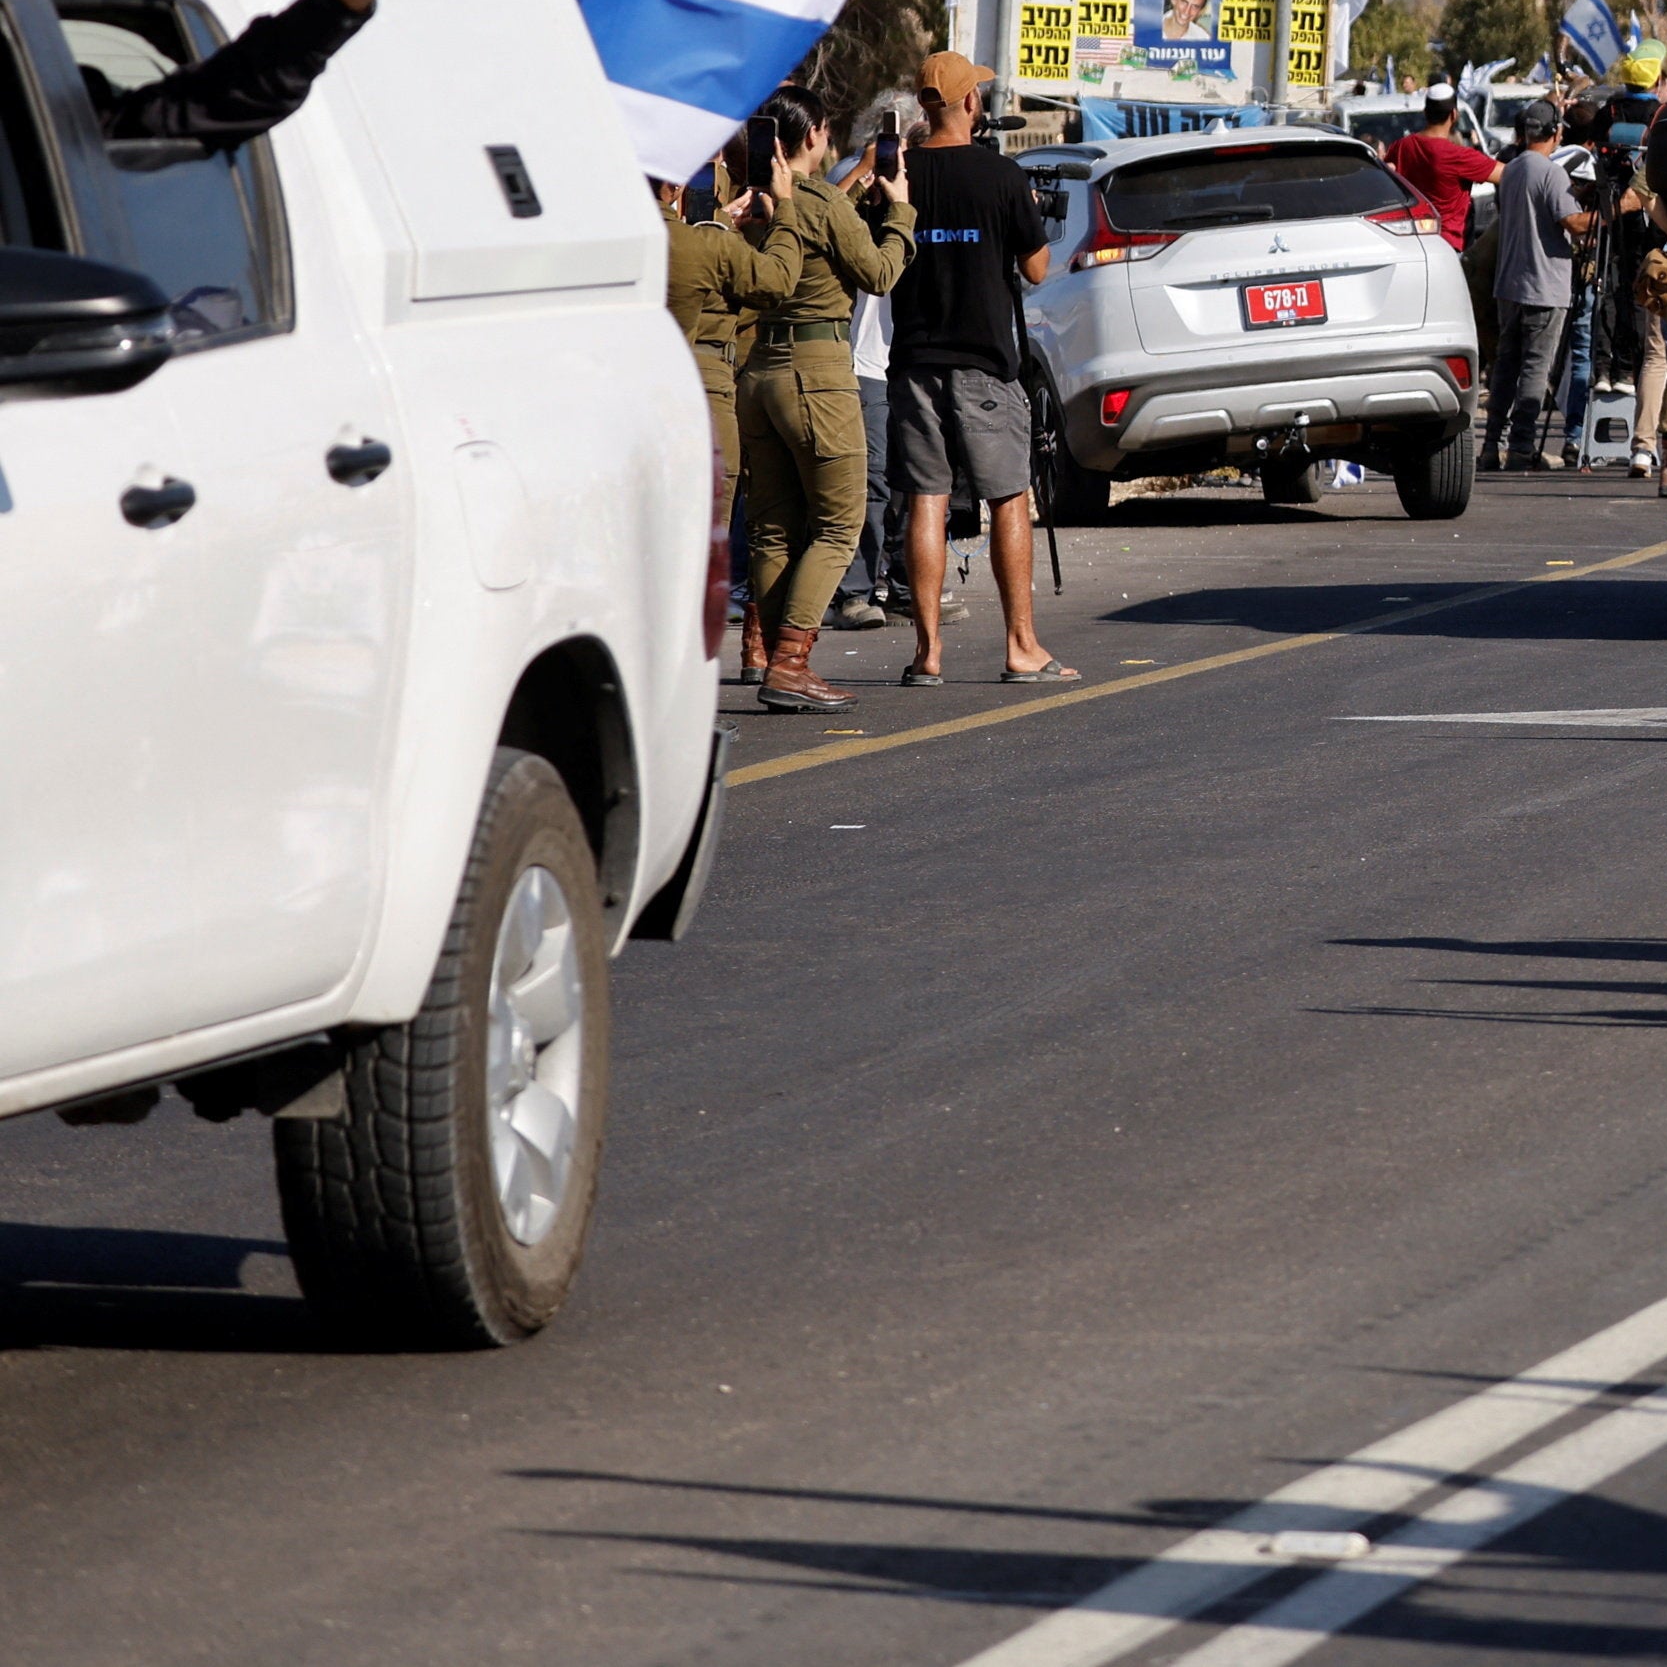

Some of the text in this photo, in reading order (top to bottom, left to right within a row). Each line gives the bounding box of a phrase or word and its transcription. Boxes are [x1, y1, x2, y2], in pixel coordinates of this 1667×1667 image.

[1022, 6, 1072, 27] נתיב
[1079, 1, 1127, 23] נתיב
[1222, 6, 1272, 28] נתיב
[1291, 11, 1325, 31] נתי
[1021, 27, 1071, 41] ההפקרה
[1078, 22, 1127, 36] ההפקרה
[1221, 27, 1271, 40] ההפקרה
[1020, 44, 1069, 65] נתיב
[1149, 47, 1226, 61] עוז וענווה
[1288, 50, 1322, 71] נתי
[1019, 65, 1068, 79] ההפקרה
